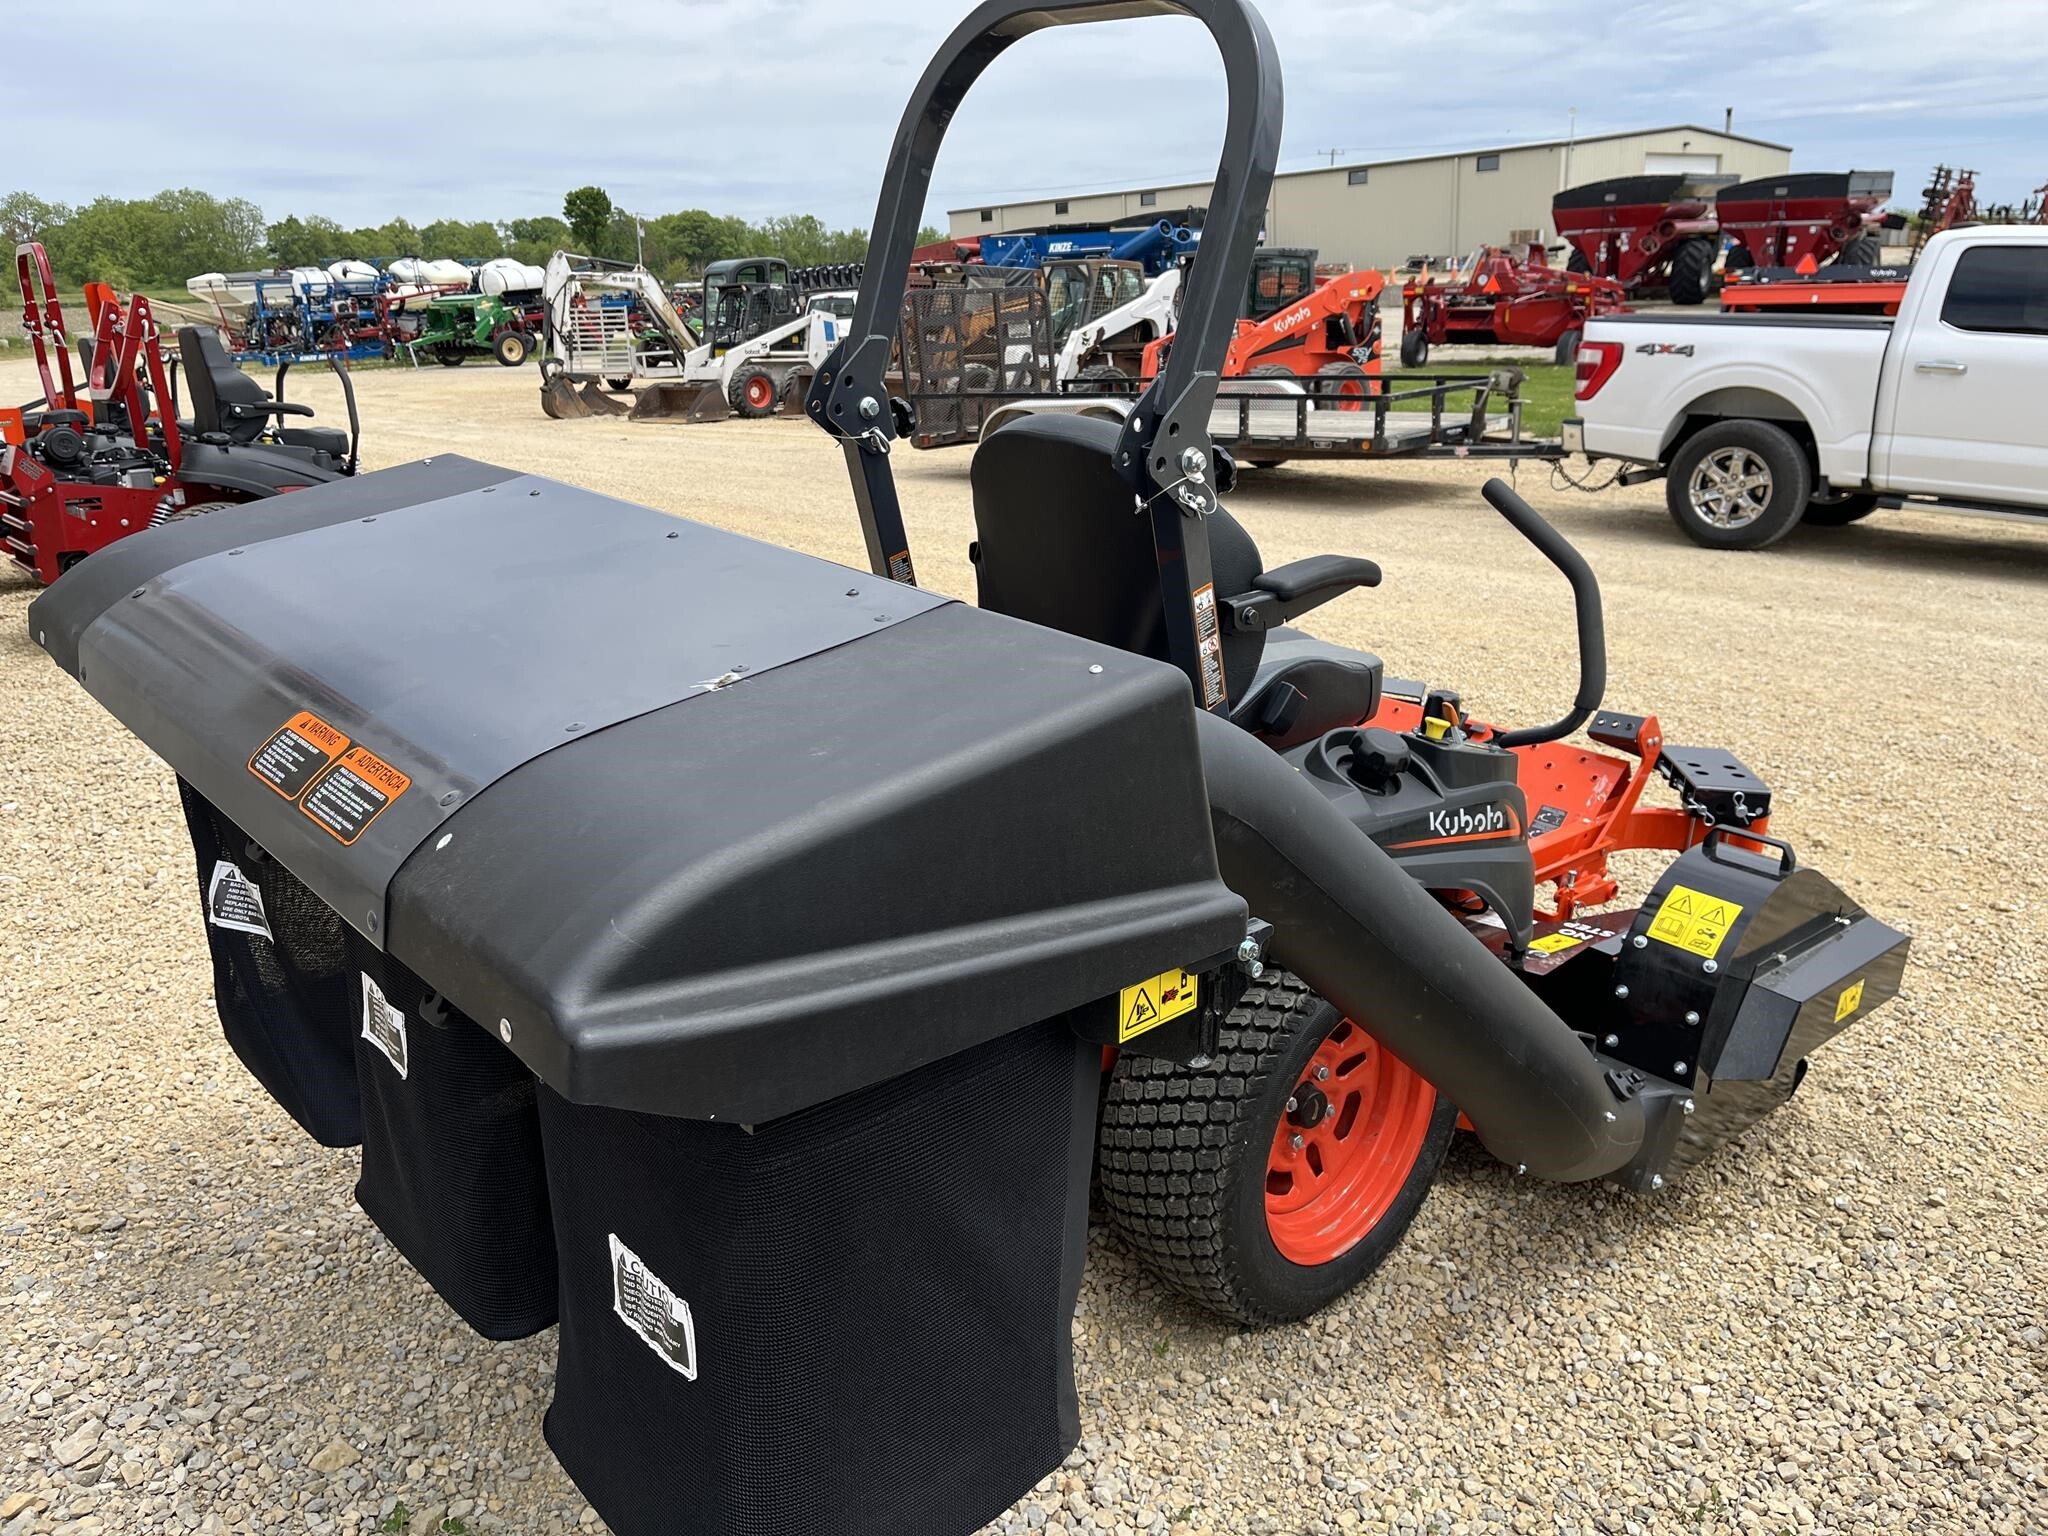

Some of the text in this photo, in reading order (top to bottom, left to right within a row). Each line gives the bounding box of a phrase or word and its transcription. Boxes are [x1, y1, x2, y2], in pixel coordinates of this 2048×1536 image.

[1048, 242, 1073, 253] KINZE
[1273, 306, 1312, 333] Kubota
[1352, 347, 1372, 357] SSV
[308, 721, 341, 746] WARNING
[355, 754, 406, 791] ADVERTENCIA
[1429, 805, 1504, 836] Kubota
[226, 893, 244, 901] CHECK
[224, 900, 248, 909] REPLACE
[233, 907, 247, 915] ONLY
[1558, 928, 1594, 941] NO
[1563, 921, 1616, 938] STEP
